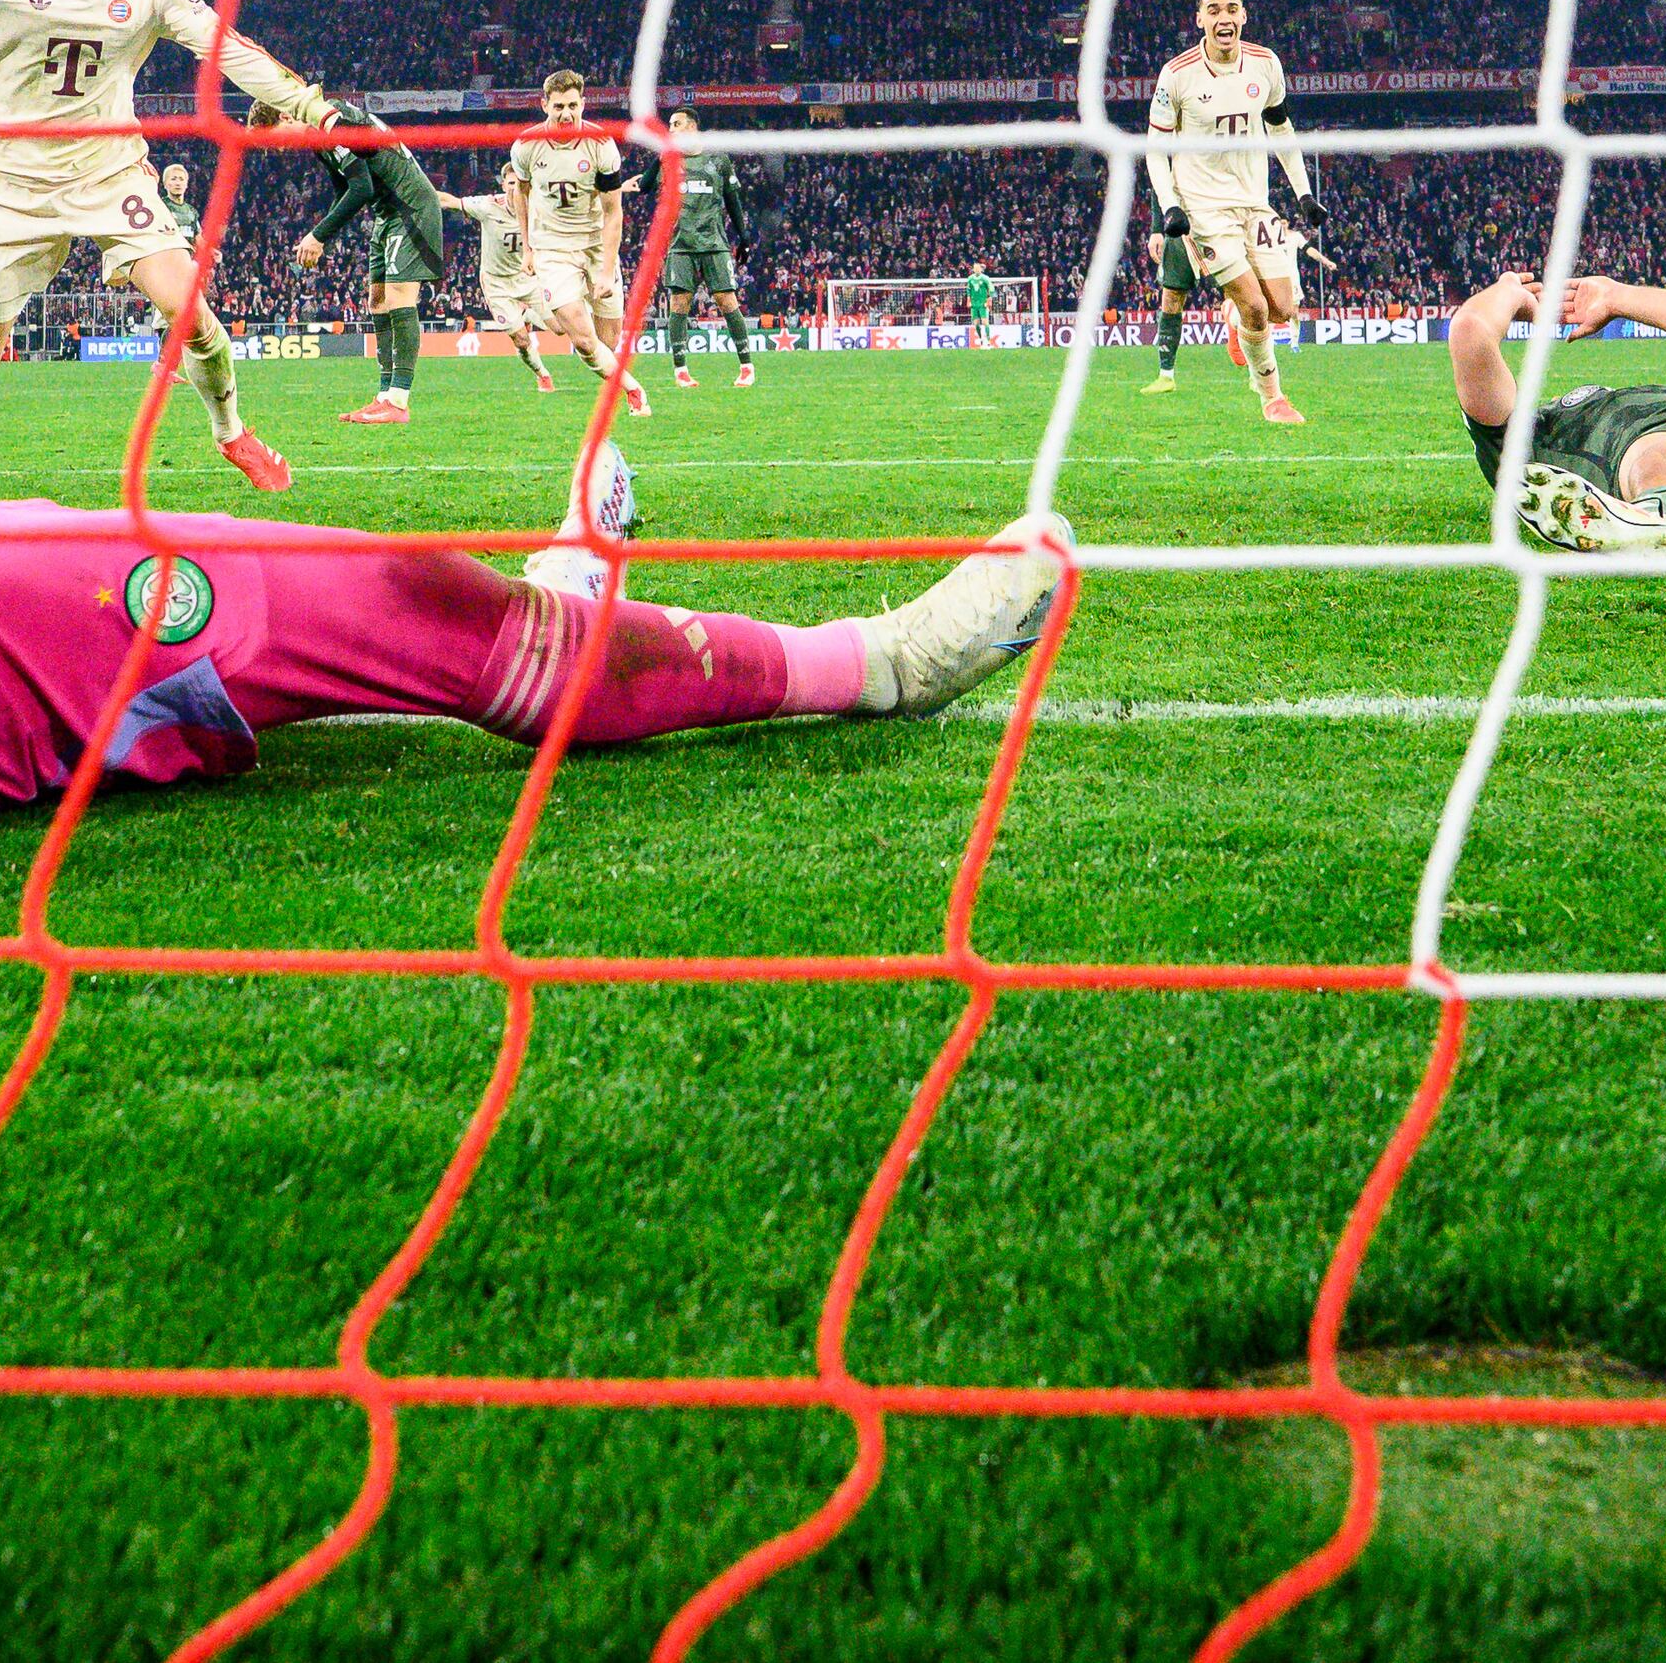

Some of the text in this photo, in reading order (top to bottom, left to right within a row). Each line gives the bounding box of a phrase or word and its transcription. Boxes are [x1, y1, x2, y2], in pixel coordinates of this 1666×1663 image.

[1388, 70, 1513, 90] OBERPFALZ
[121, 194, 154, 230] 8
[1257, 216, 1285, 249] 42
[615, 330, 769, 354] eieken
[1056, 325, 1143, 347] QTAR
[1315, 319, 1428, 345] PEPSI
[87, 341, 155, 356] RECYCLE
[233, 334, 322, 360] et365
